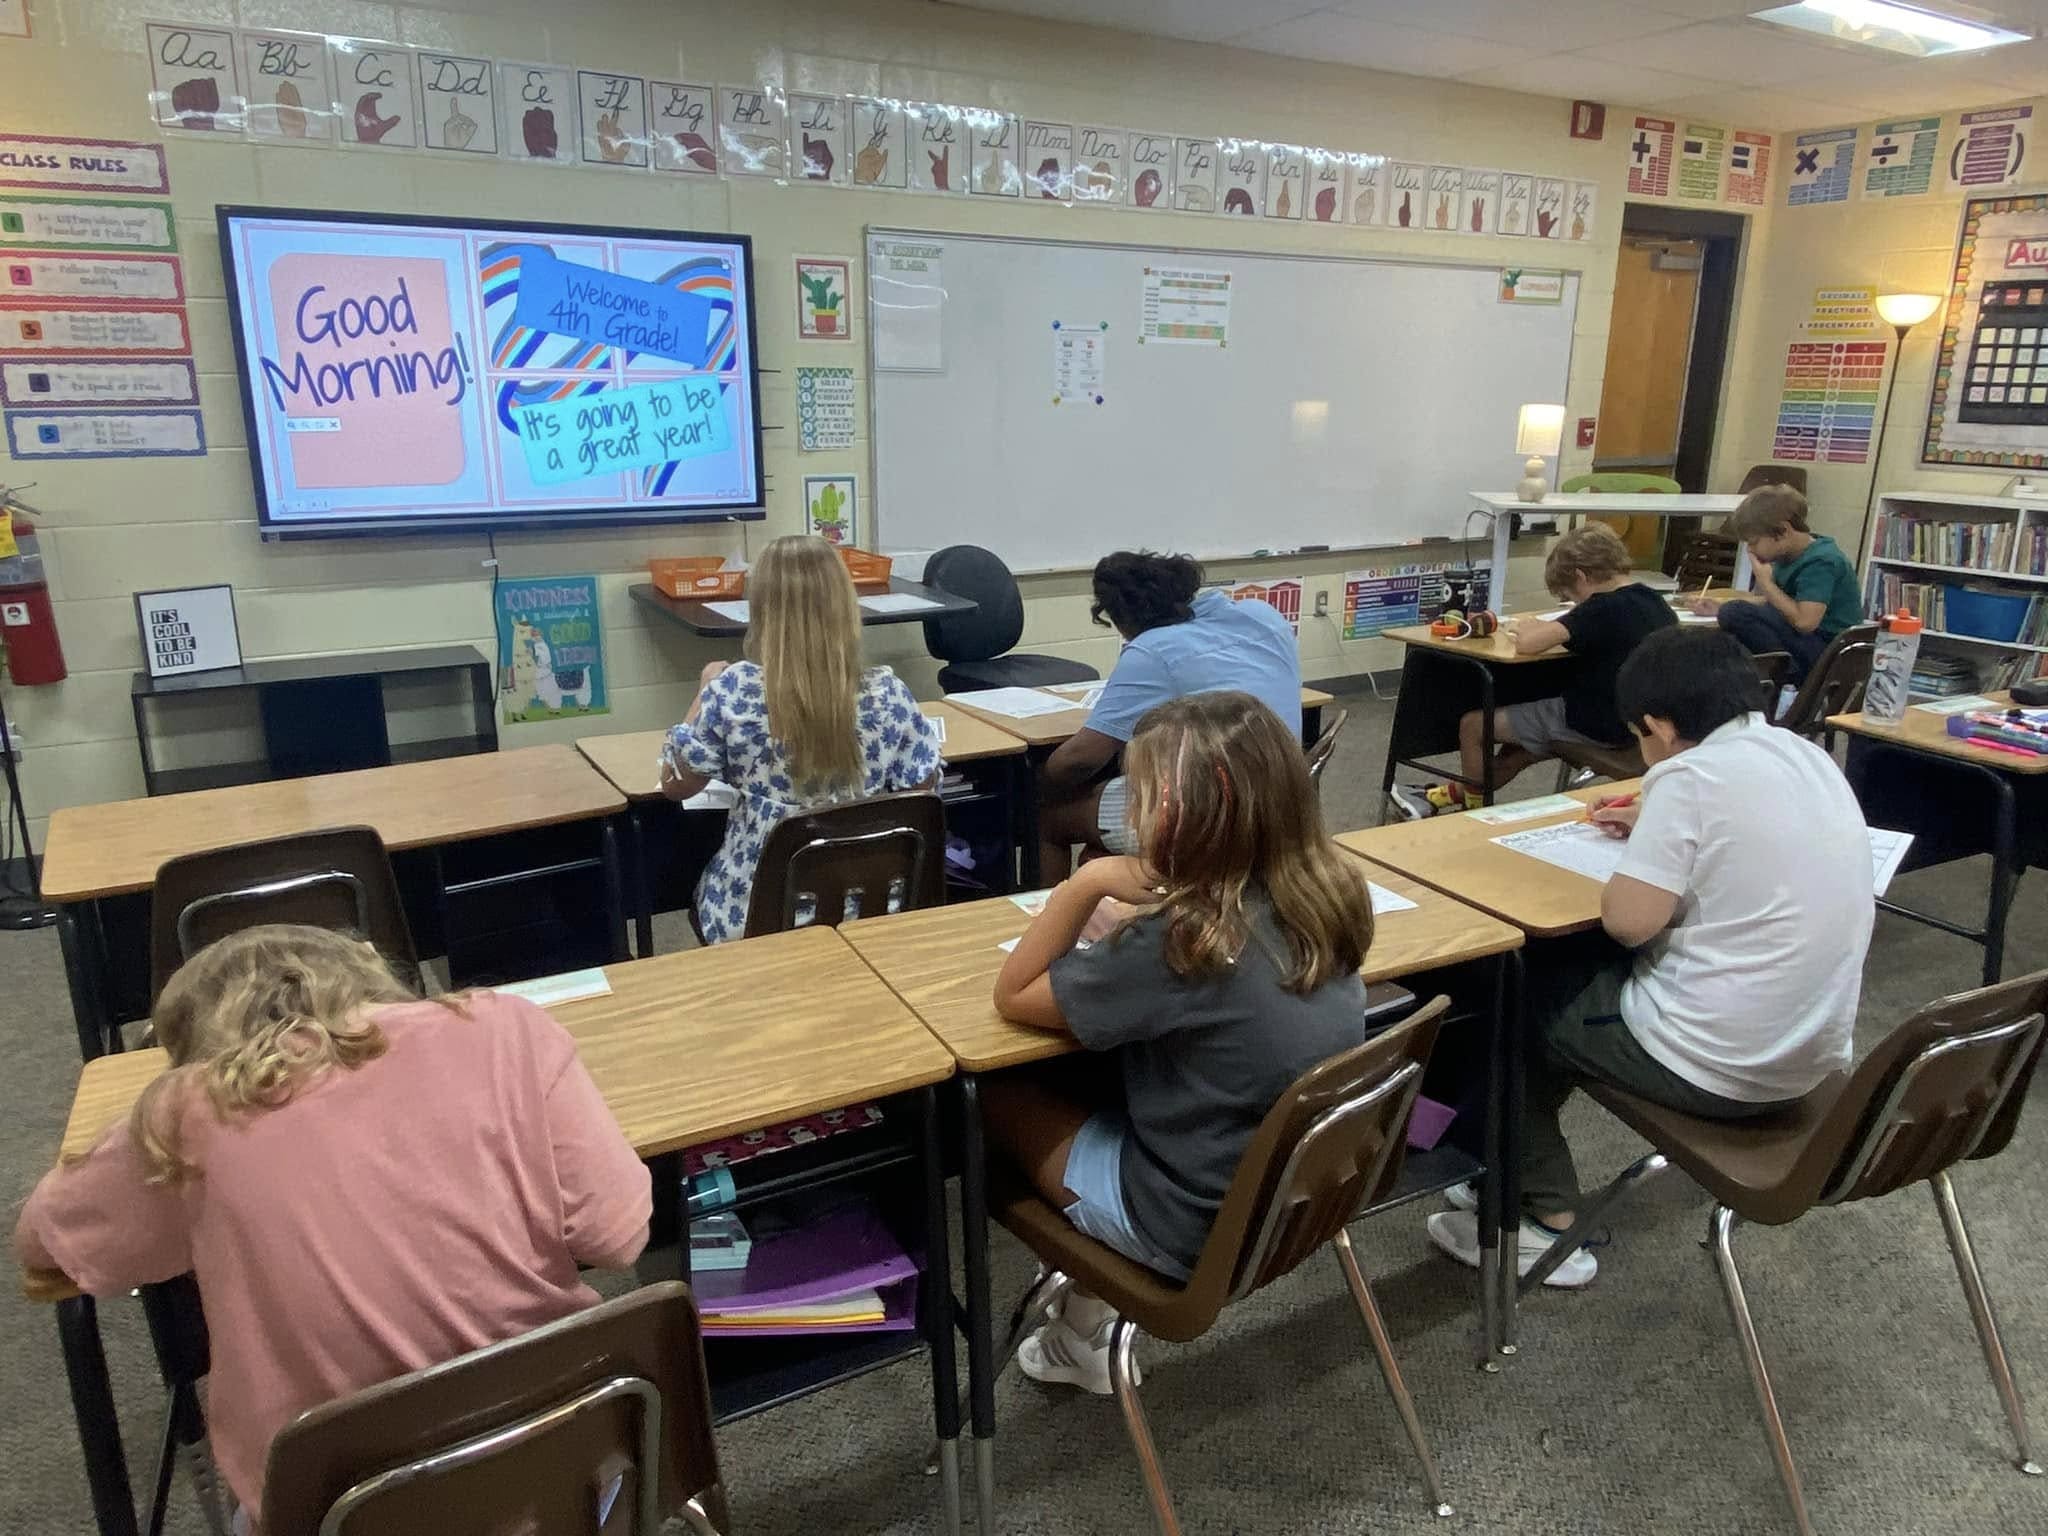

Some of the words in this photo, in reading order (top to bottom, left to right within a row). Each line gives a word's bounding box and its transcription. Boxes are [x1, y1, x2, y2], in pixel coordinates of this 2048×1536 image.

[161, 31, 226, 70] Aa
[258, 40, 311, 76] Bb
[355, 52, 394, 86] Cc
[427, 59, 488, 96] Dd
[521, 71, 553, 103] Ee
[595, 79, 628, 122] Ff
[662, 88, 705, 130] Gg
[732, 92, 770, 126] Hh
[921, 114, 957, 144] Kk
[1027, 126, 1071, 150] Mm
[1081, 130, 1120, 159] Nn
[0, 153, 61, 169] CLASS
[69, 156, 128, 172] RULES
[1134, 137, 1167, 163] Oo
[1185, 142, 1209, 177] Pp
[2008, 239, 2048, 272] Au
[296, 276, 418, 347] Good
[564, 275, 650, 318] Welcome
[656, 304, 669, 322] to
[24, 323, 37, 335] 3
[549, 300, 590, 336] 4th
[604, 311, 679, 354] Grade!
[260, 331, 474, 411] Morning!
[523, 409, 562, 443] It's
[576, 396, 640, 443] going
[648, 388, 673, 416] to
[685, 385, 717, 411] be
[43, 427, 56, 440] 5
[546, 448, 565, 471] a
[577, 427, 641, 475] great
[656, 413, 714, 460] year!
[1369, 568, 1401, 578] ORDER
[1404, 566, 1416, 575] OF
[152, 610, 177, 623] IT'S
[154, 624, 189, 638] COOL
[157, 639, 173, 652] TO
[177, 638, 193, 650] BE
[159, 652, 192, 667] KIND
